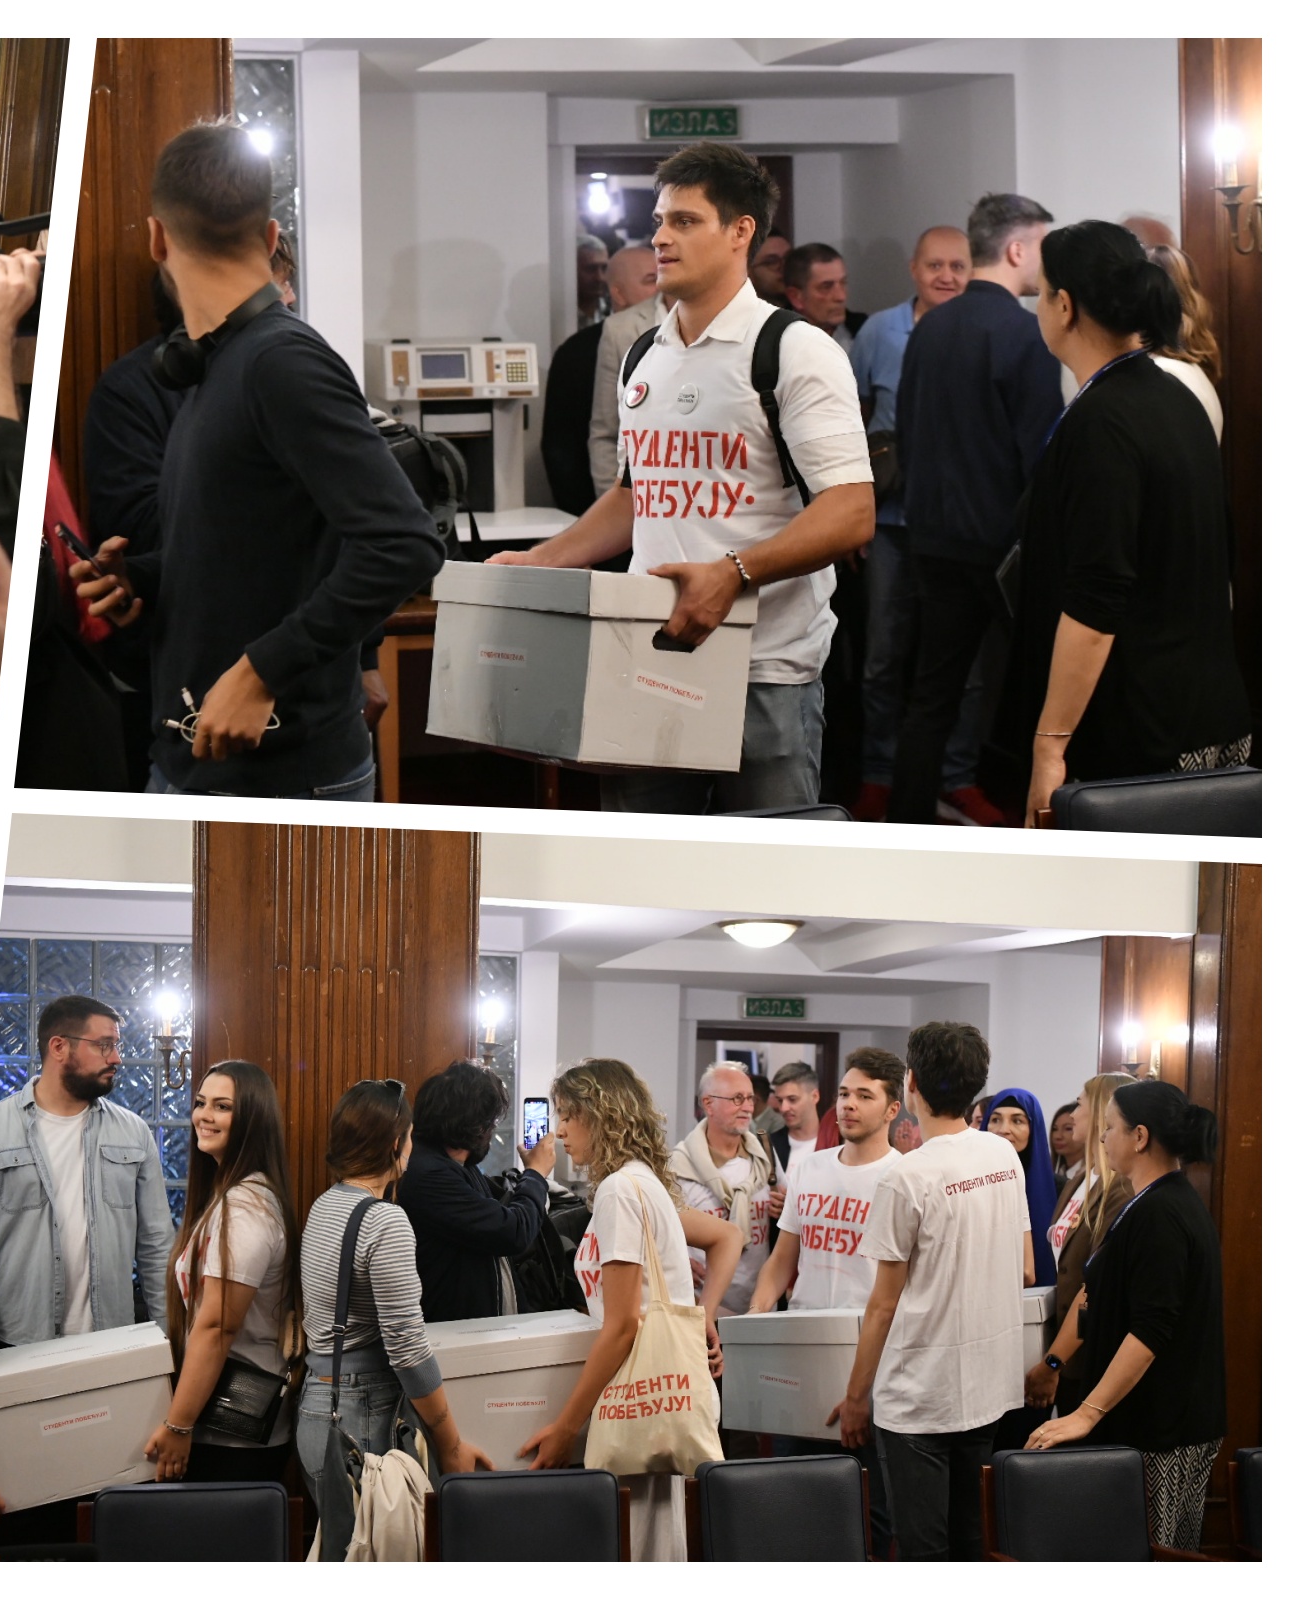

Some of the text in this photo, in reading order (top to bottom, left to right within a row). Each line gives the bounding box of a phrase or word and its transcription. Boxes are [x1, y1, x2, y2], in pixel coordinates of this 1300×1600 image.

[653, 111, 735, 133] ИЗЛАЗ
[749, 1000, 803, 1016] ИЗЛАЗ
[945, 1176, 985, 1196] СТУДЕНТИ
[797, 1193, 871, 1225] СТУДЕН
[599, 1395, 692, 1421] ПОБЕЂУЈУ!
